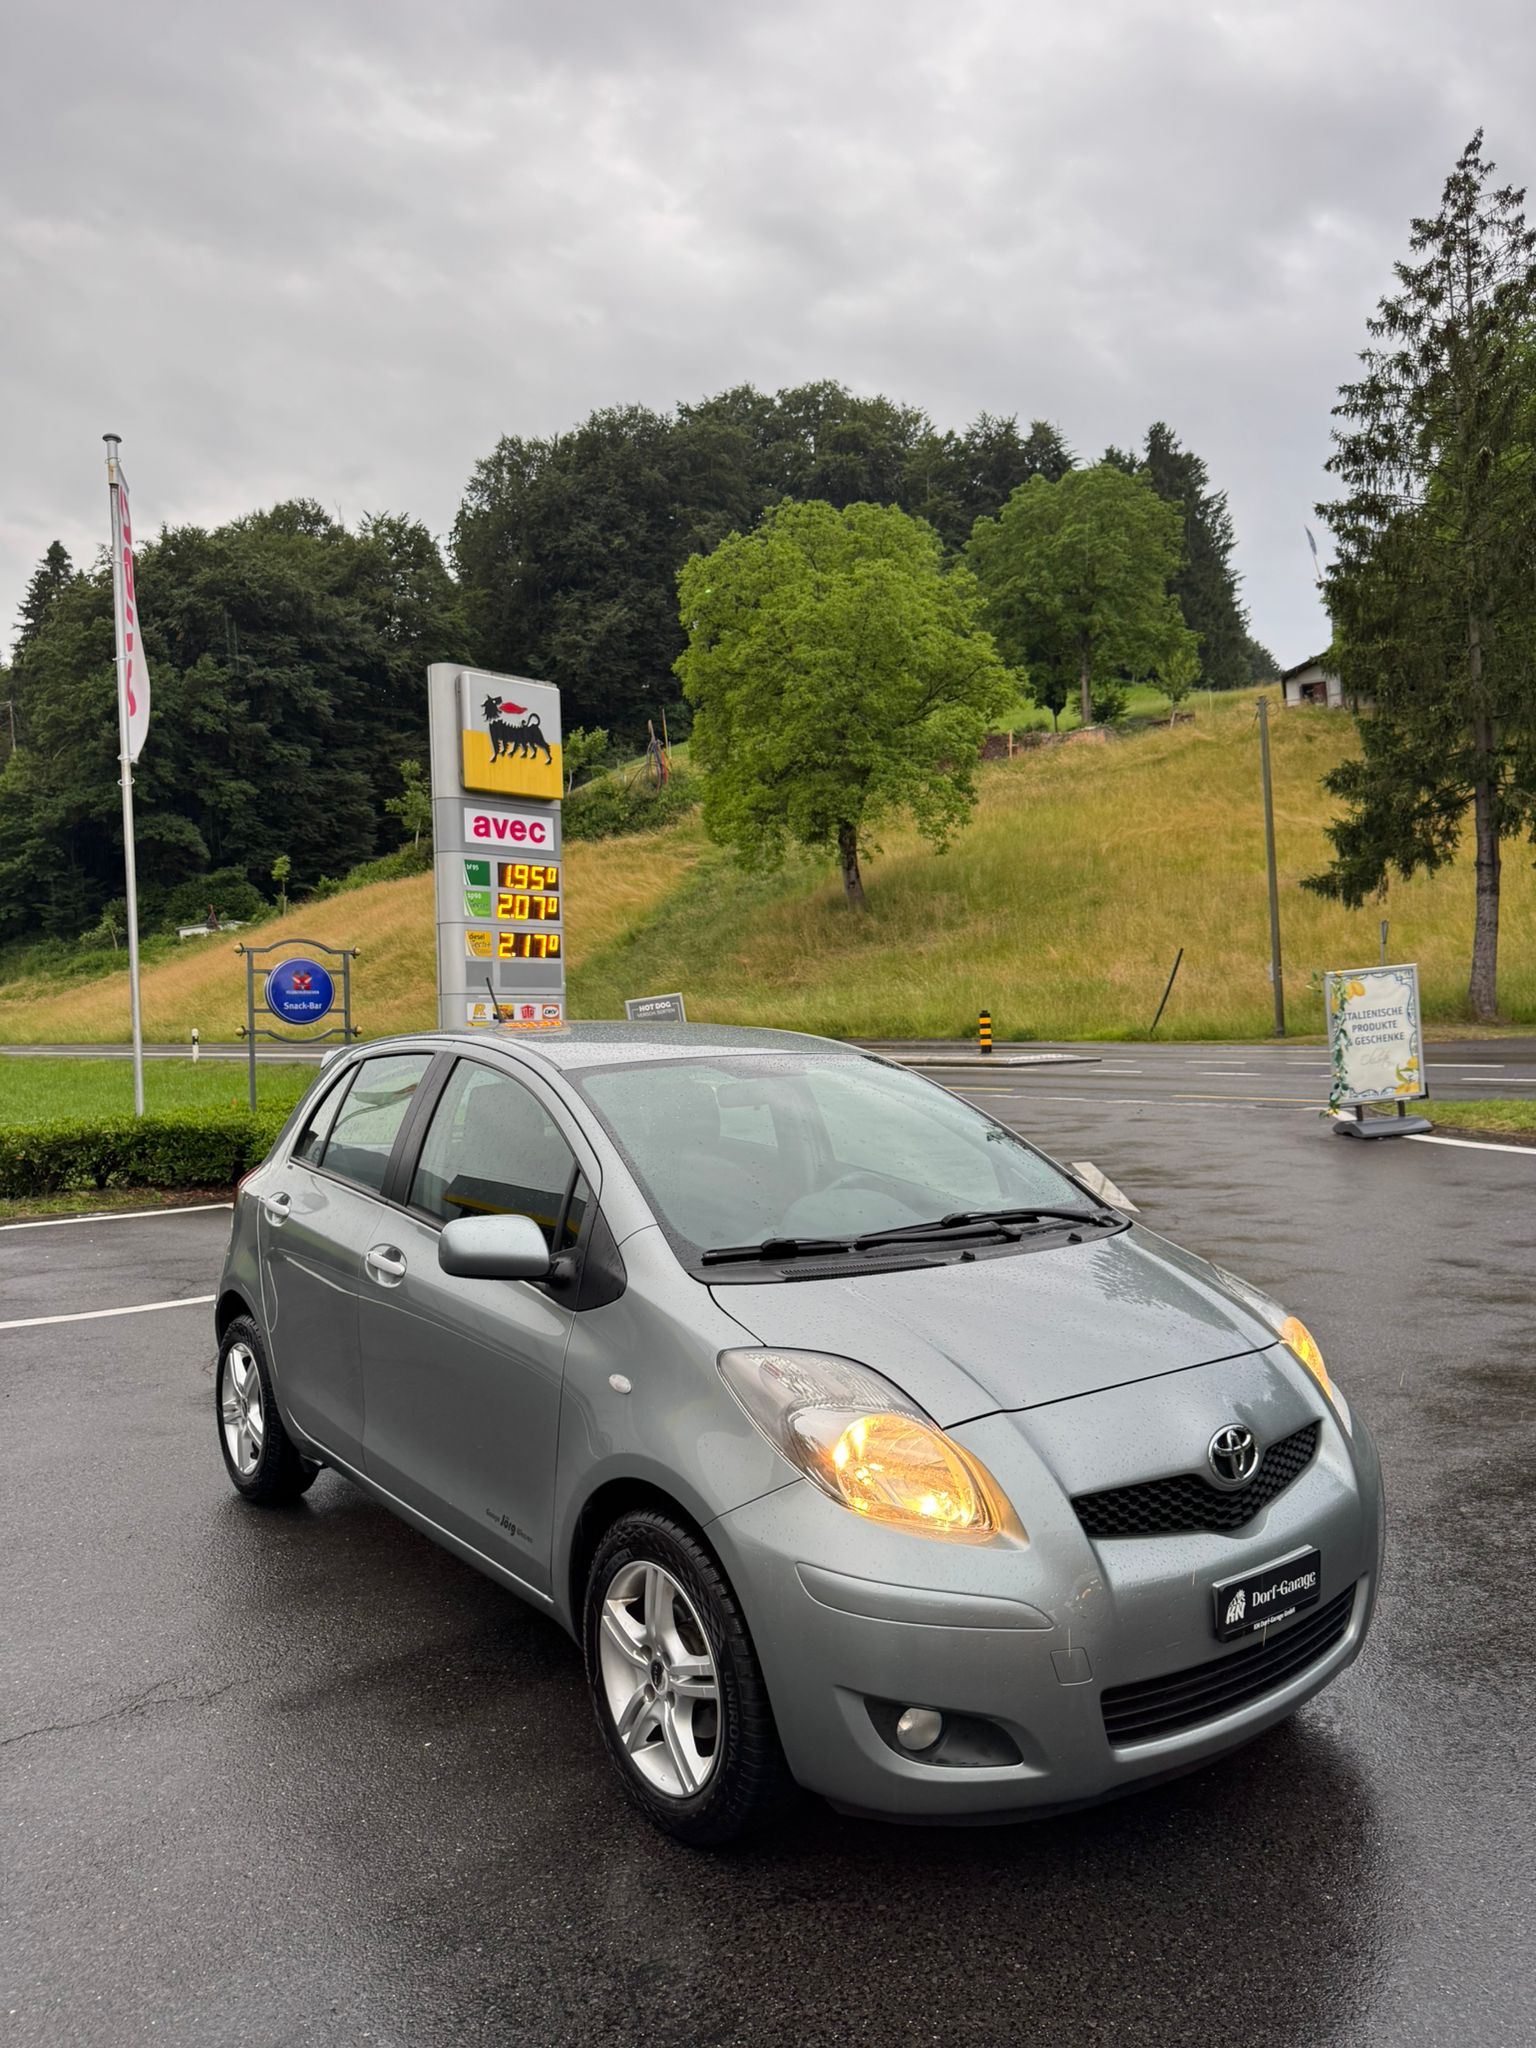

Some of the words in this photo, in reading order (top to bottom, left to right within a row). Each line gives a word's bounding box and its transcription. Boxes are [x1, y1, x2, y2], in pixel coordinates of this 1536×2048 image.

[473, 815, 546, 843] avec
[283, 1001, 322, 1010] Snack-Bar
[638, 1003, 655, 1012] HOT
[655, 1001, 672, 1009] DOG
[1352, 1020, 1398, 1033] PRODUKTE
[1354, 1032, 1405, 1046] GESCHENKE
[1252, 1571, 1316, 1607] Dorf-Garage
[724, 1672, 740, 1770] UNIROYAL
